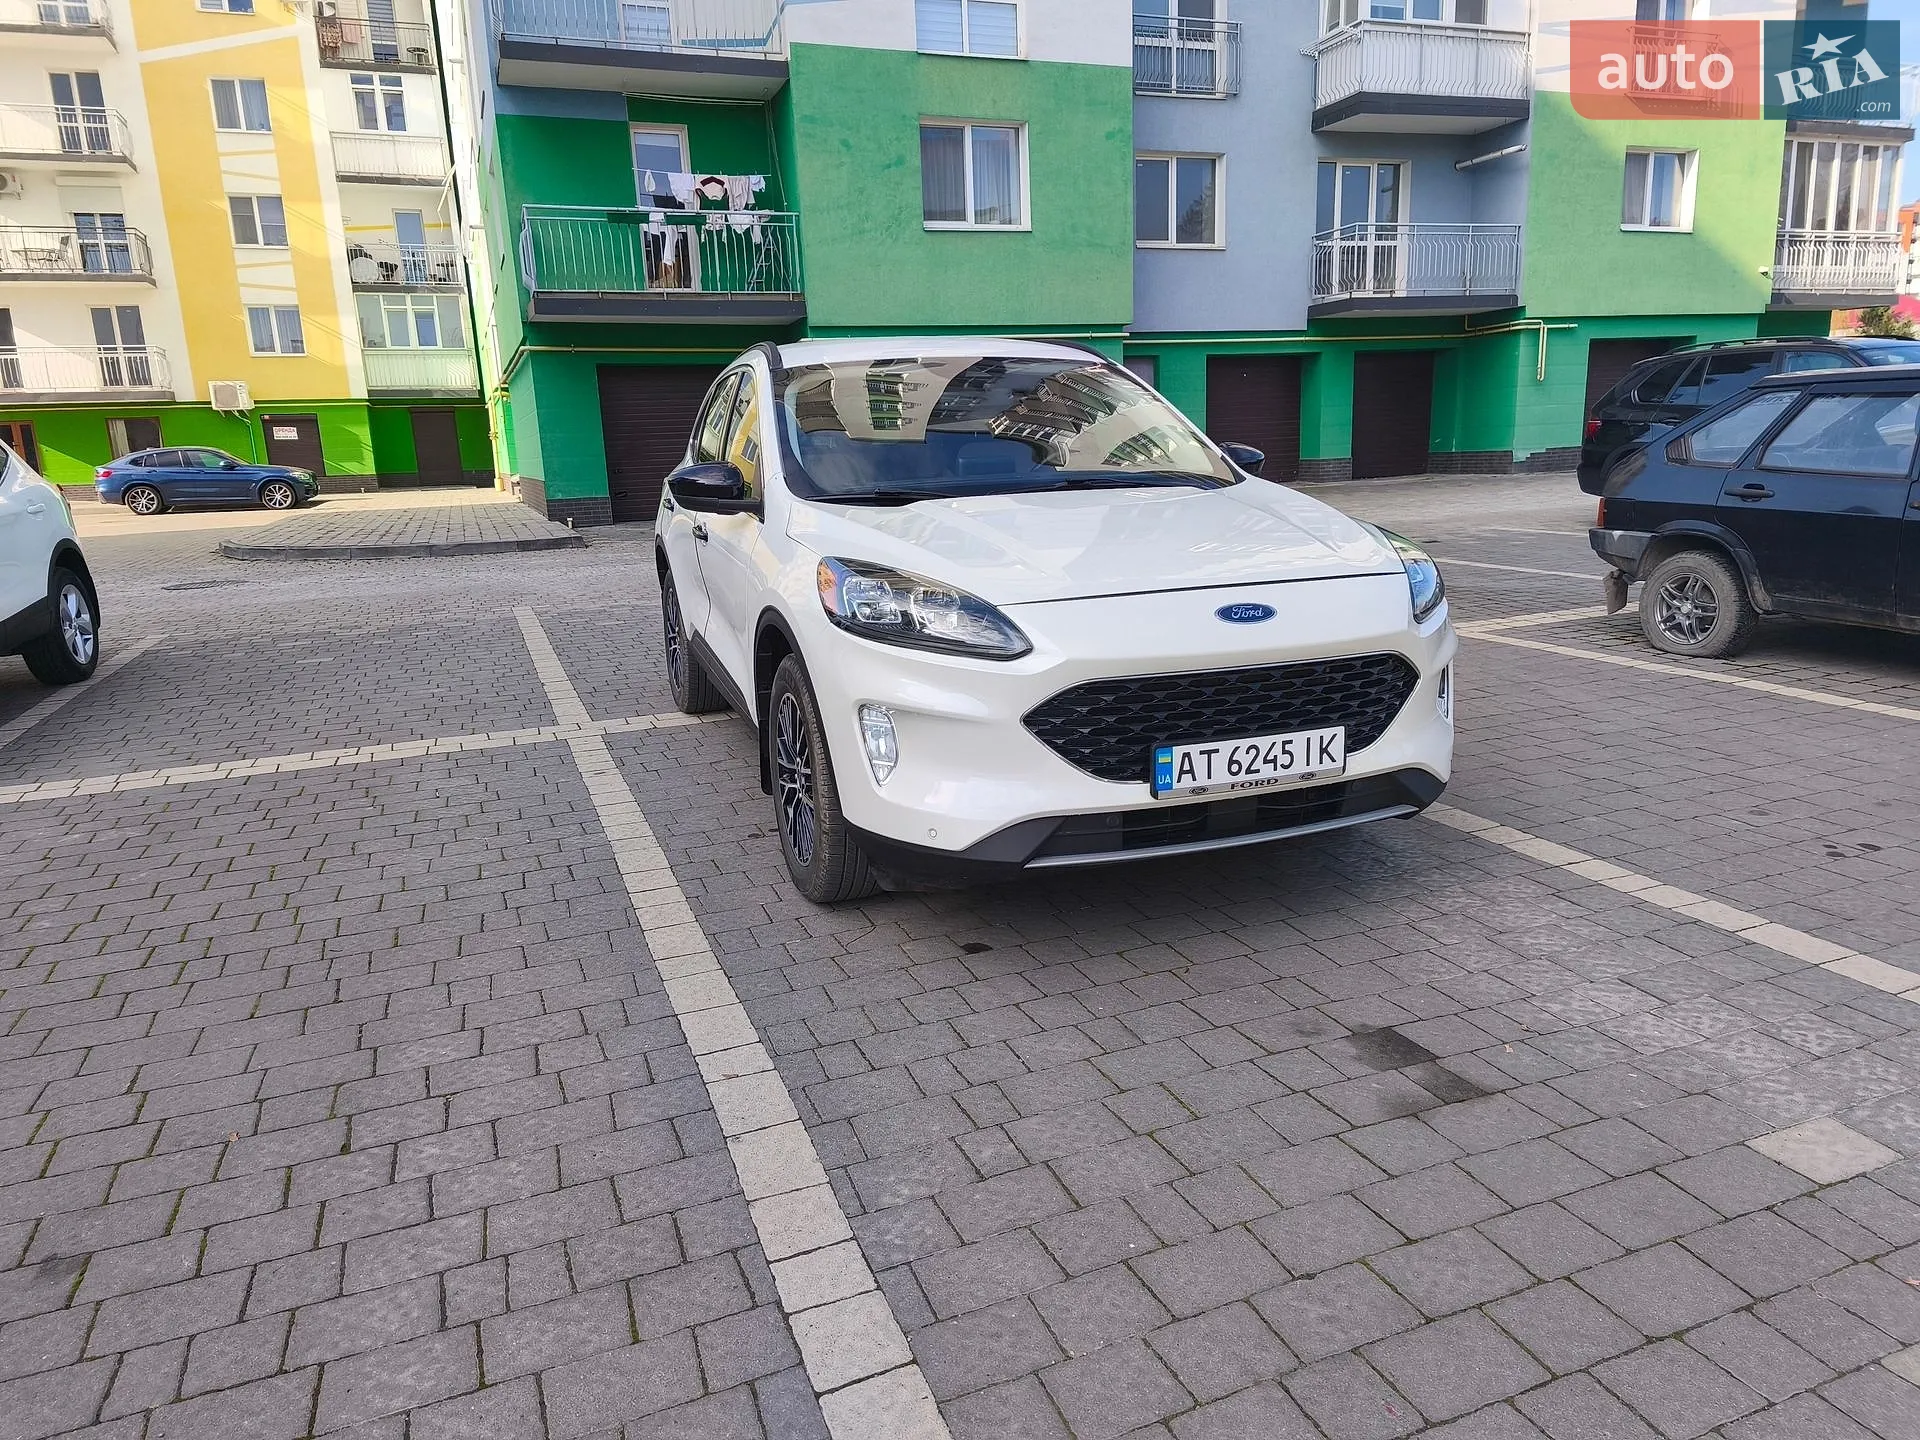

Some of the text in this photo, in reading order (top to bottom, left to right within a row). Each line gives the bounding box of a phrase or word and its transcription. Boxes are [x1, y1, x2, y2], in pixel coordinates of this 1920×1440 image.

[1231, 605, 1265, 619] Ford
[1176, 733, 1338, 783] AT 6245 IK
[1158, 775, 1172, 785] UA
[1230, 778, 1279, 790] FORD
